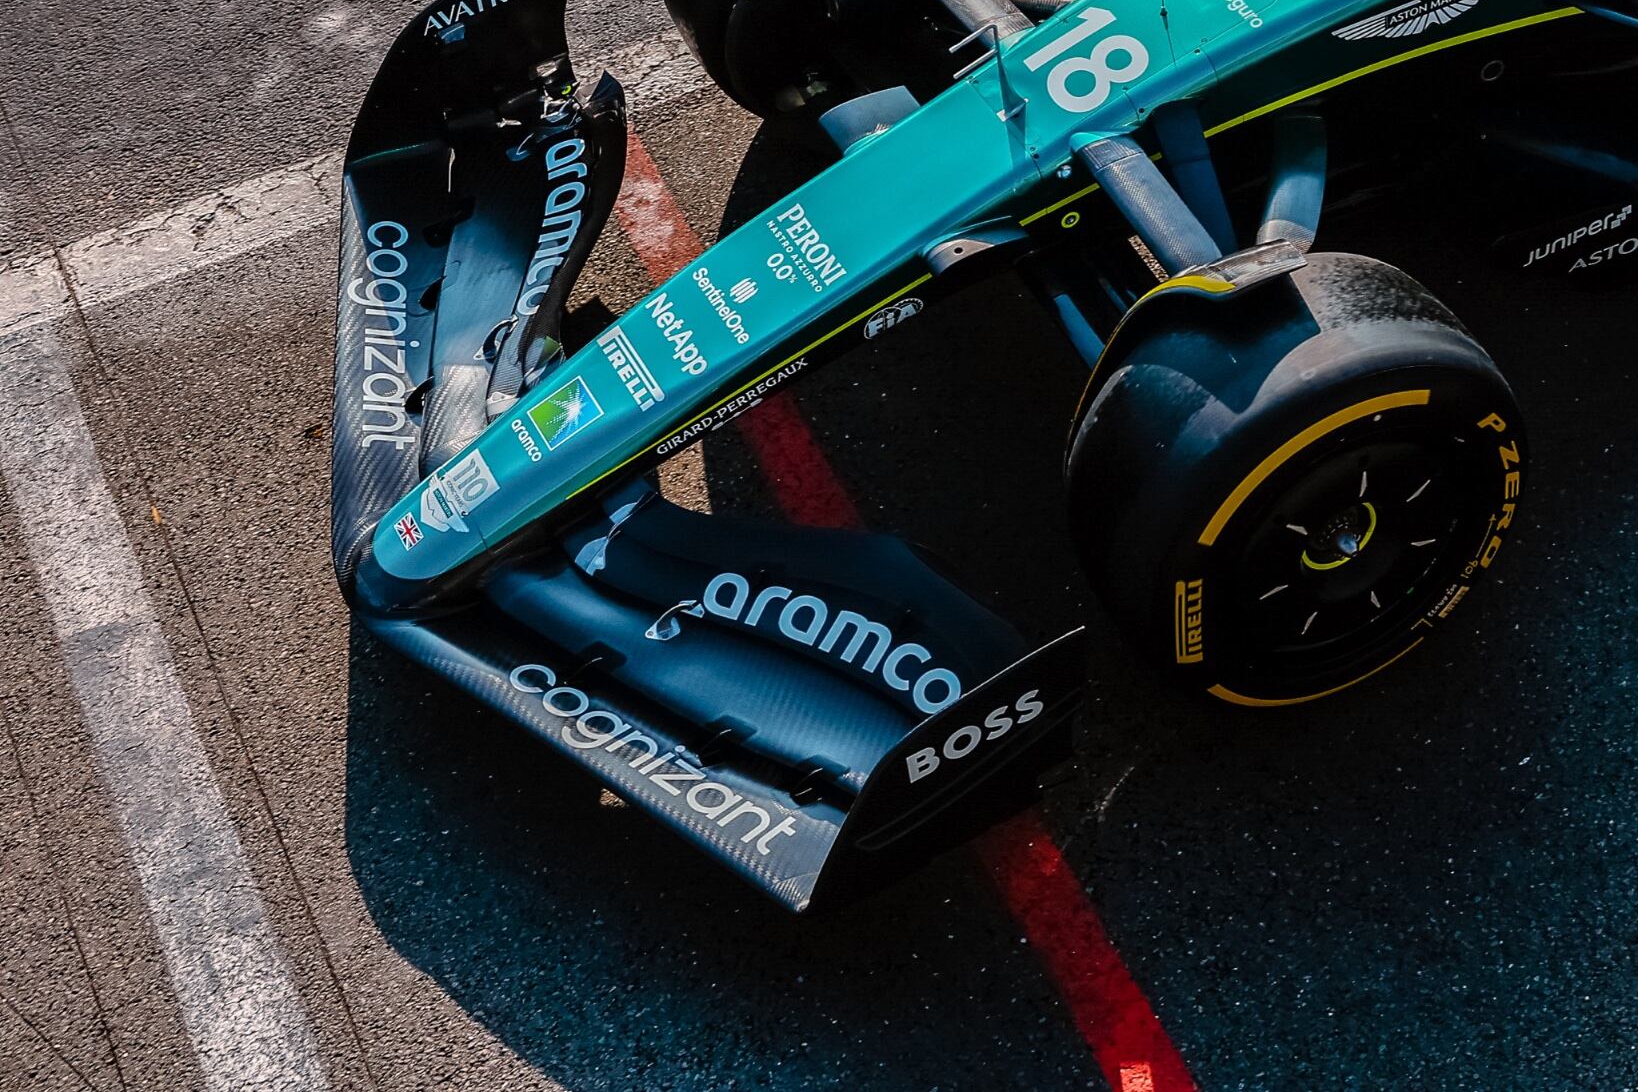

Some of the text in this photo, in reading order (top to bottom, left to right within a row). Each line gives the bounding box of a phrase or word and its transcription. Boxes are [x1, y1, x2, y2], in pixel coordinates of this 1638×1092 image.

[1389, 3, 1428, 25] ASTON
[1023, 6, 1149, 113] 18
[517, 138, 588, 316] aramco
[766, 220, 823, 293] NASTRO AZZURRO
[766, 253, 798, 284] 0.0%
[776, 203, 847, 286] PERONI
[365, 220, 416, 450] cognizant
[645, 292, 709, 376] NetApp
[692, 267, 750, 345] SentinelOne
[598, 325, 665, 412] PIRELLI
[656, 357, 809, 456] GIRARD-PERREGAUX
[452, 458, 490, 502] 110
[511, 418, 543, 463] aramco
[1477, 412, 1521, 569] P ZERO
[703, 572, 962, 715] aramco
[1175, 578, 1205, 665] PIRELLI
[509, 663, 798, 856] cognizant
[906, 689, 1045, 784] BOSS
